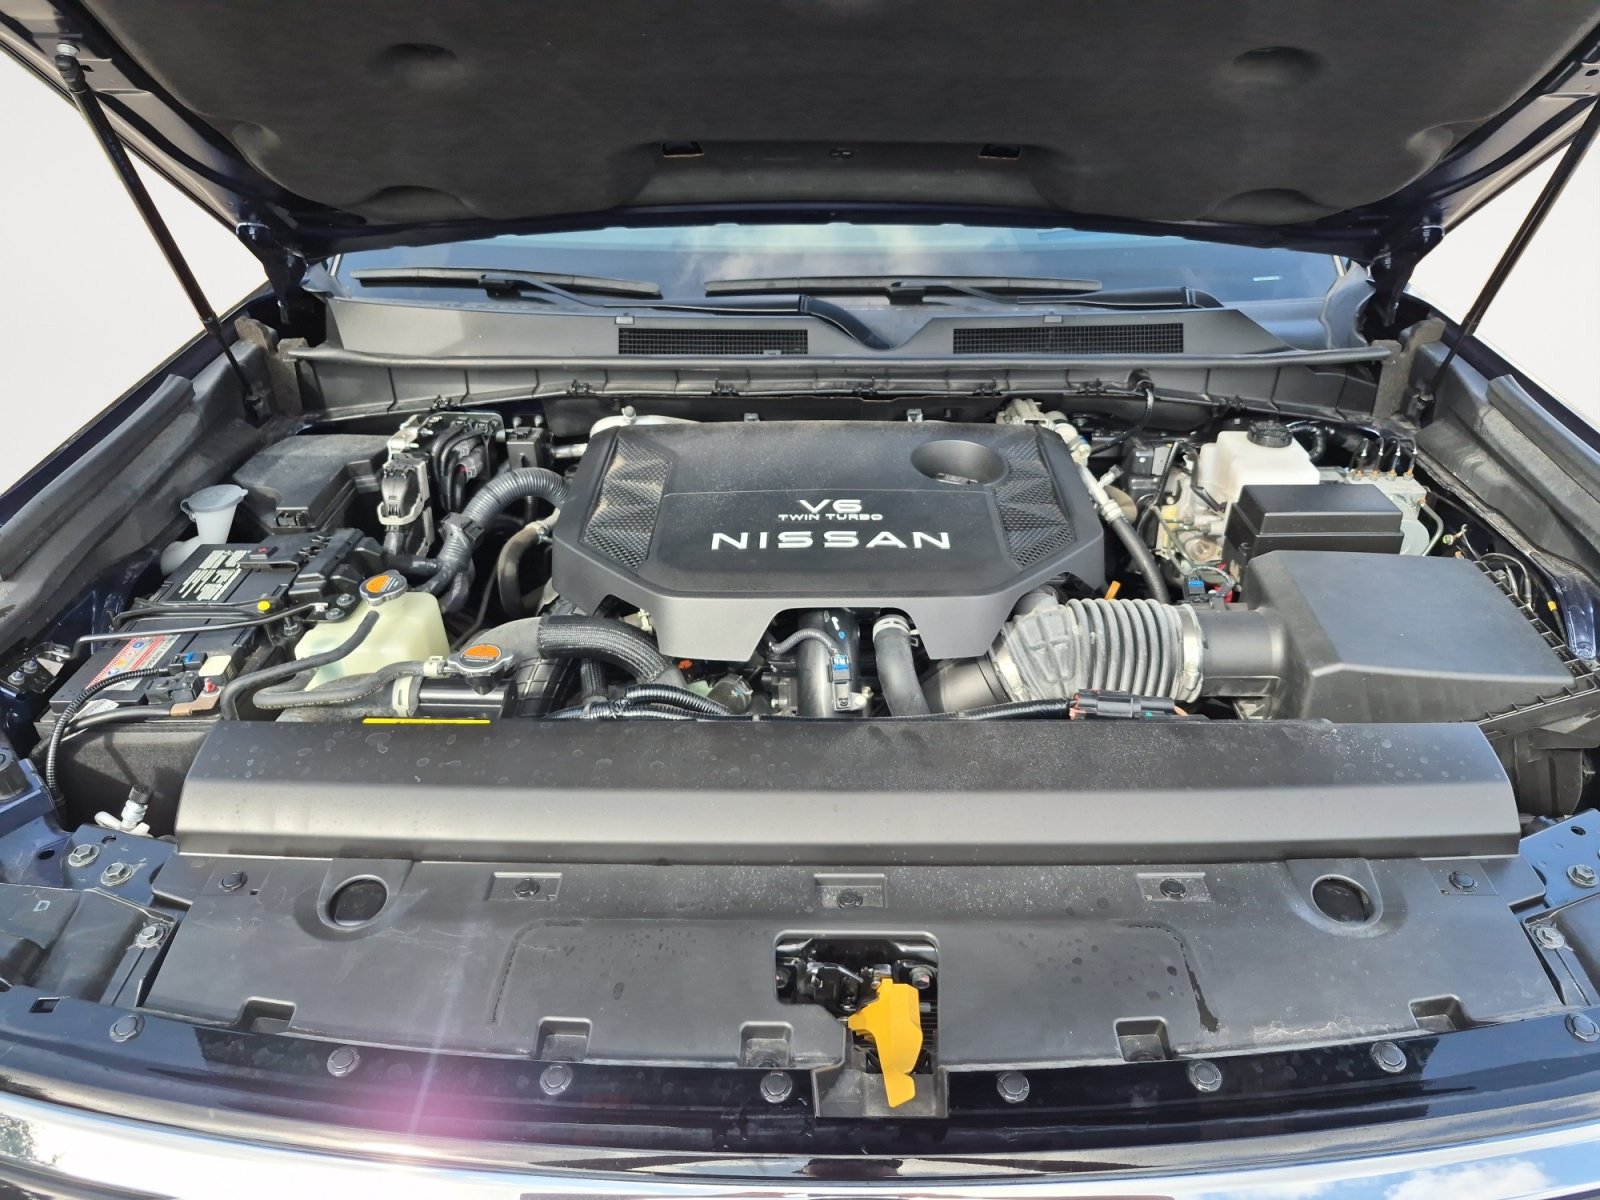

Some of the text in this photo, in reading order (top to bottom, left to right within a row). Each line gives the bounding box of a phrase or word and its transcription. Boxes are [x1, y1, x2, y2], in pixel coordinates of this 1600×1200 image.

[799, 499, 862, 514] V6
[777, 513, 883, 522] TWIN TURBO
[711, 531, 951, 551] NISSAN
